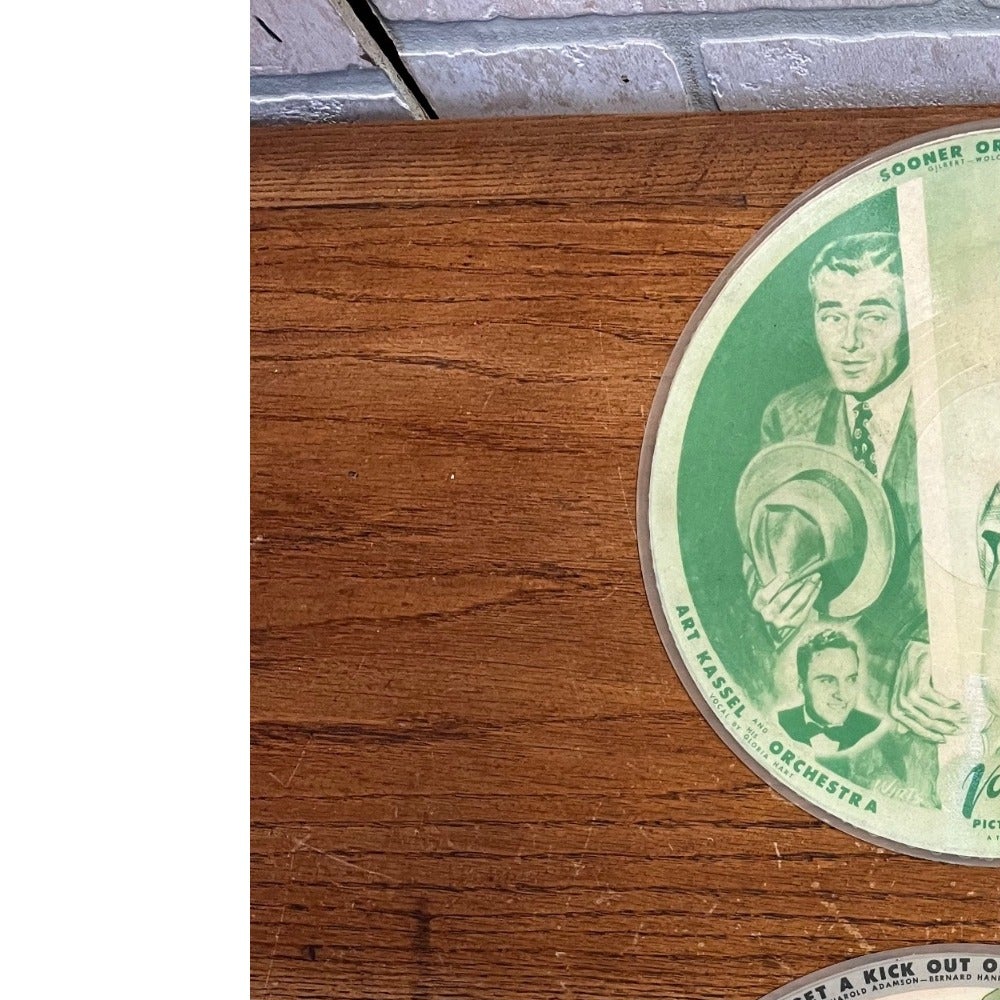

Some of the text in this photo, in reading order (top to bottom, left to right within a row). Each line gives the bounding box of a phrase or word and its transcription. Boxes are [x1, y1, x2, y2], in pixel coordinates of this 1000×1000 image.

[879, 145, 963, 182] SOONER
[675, 605, 877, 813] ART KASSEL AND HIS ORCHESTRA
[710, 693, 730, 719] VOCAL
[731, 721, 741, 730] BY
[744, 733, 769, 759] GLORIA
[839, 976, 854, 993] A
[863, 961, 915, 985] KICK
[926, 958, 971, 974] OUT
